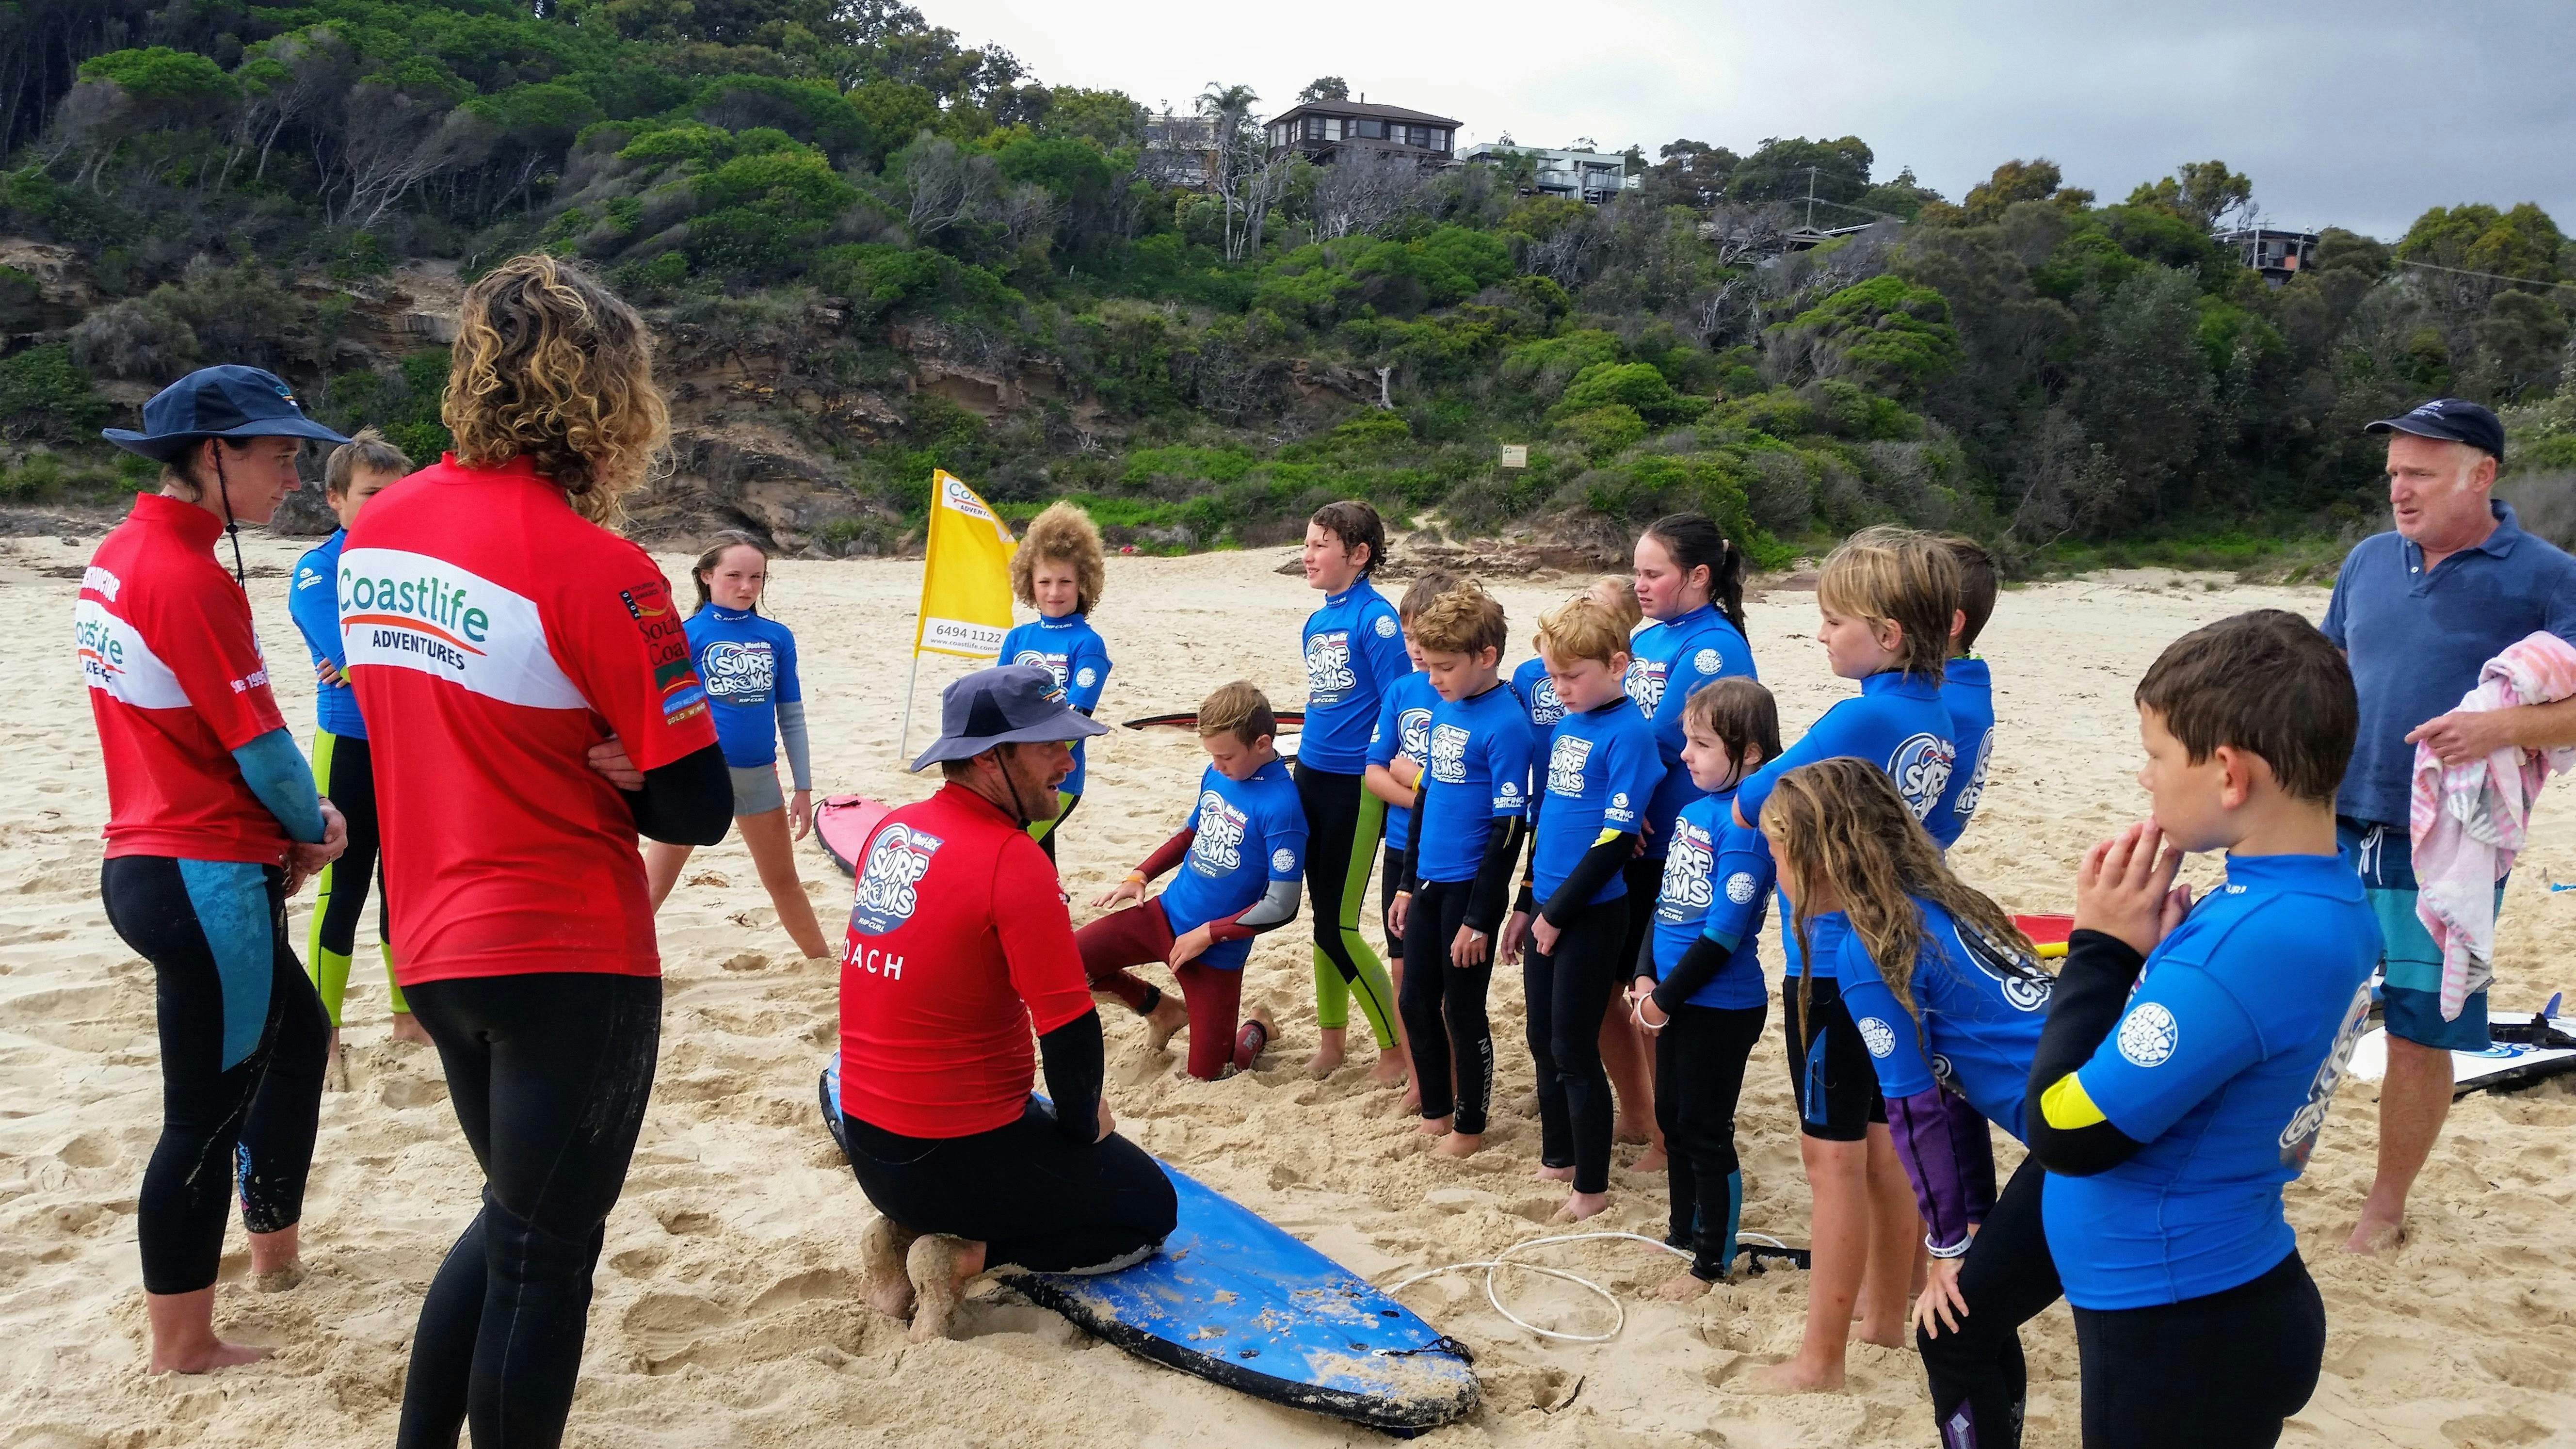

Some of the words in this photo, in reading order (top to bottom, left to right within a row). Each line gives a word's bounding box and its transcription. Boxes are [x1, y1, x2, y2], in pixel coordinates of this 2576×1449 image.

[961, 505, 991, 517] ADVENT
[339, 568, 489, 642] Coastlife
[937, 625, 967, 638] 6494
[972, 630, 1001, 643] 1122
[372, 630, 466, 671] ADVENTURES
[650, 643, 685, 666] Coa
[1308, 648, 1348, 675] SURF
[716, 654, 773, 675] SURF
[708, 672, 773, 694] GROMS
[1625, 677, 1666, 706] SURF
[1539, 691, 1562, 708] SU
[1404, 728, 1429, 754] SU
[1431, 738, 1464, 761] SURF
[1548, 750, 1584, 773] SURF
[1493, 796, 1524, 805] SURFING
[1198, 808, 1241, 847] SURF
[911, 832, 943, 852] Weet-Bix
[869, 847, 927, 886] SURF
[1200, 866, 1217, 877] CURL
[858, 917, 870, 926] RIP
[868, 921, 885, 933] CURL
[1664, 911, 1683, 922] CURL
[842, 937, 904, 981] OACH
[2136, 1005, 2170, 1029] RIP
[1478, 1037, 1492, 1113] ADRENALIN
